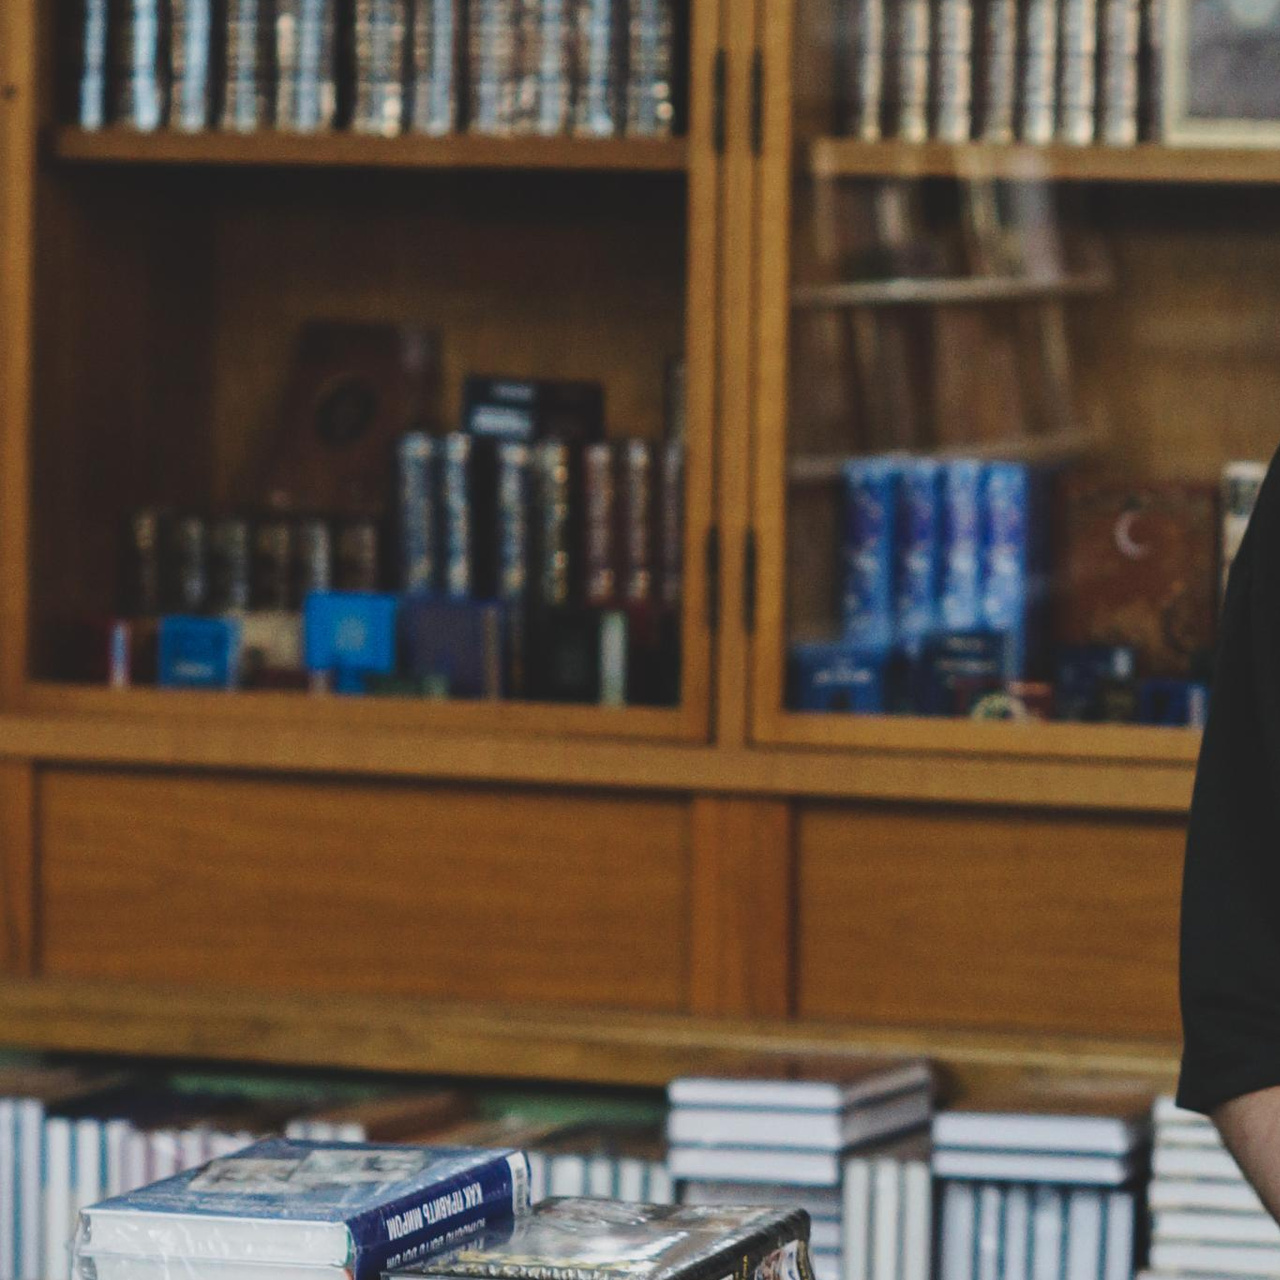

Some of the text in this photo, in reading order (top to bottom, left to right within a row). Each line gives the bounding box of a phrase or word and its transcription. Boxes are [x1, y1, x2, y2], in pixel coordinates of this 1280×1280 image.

[386, 1182, 484, 1241] КАК ПРАВИТЬ МИРОМ
